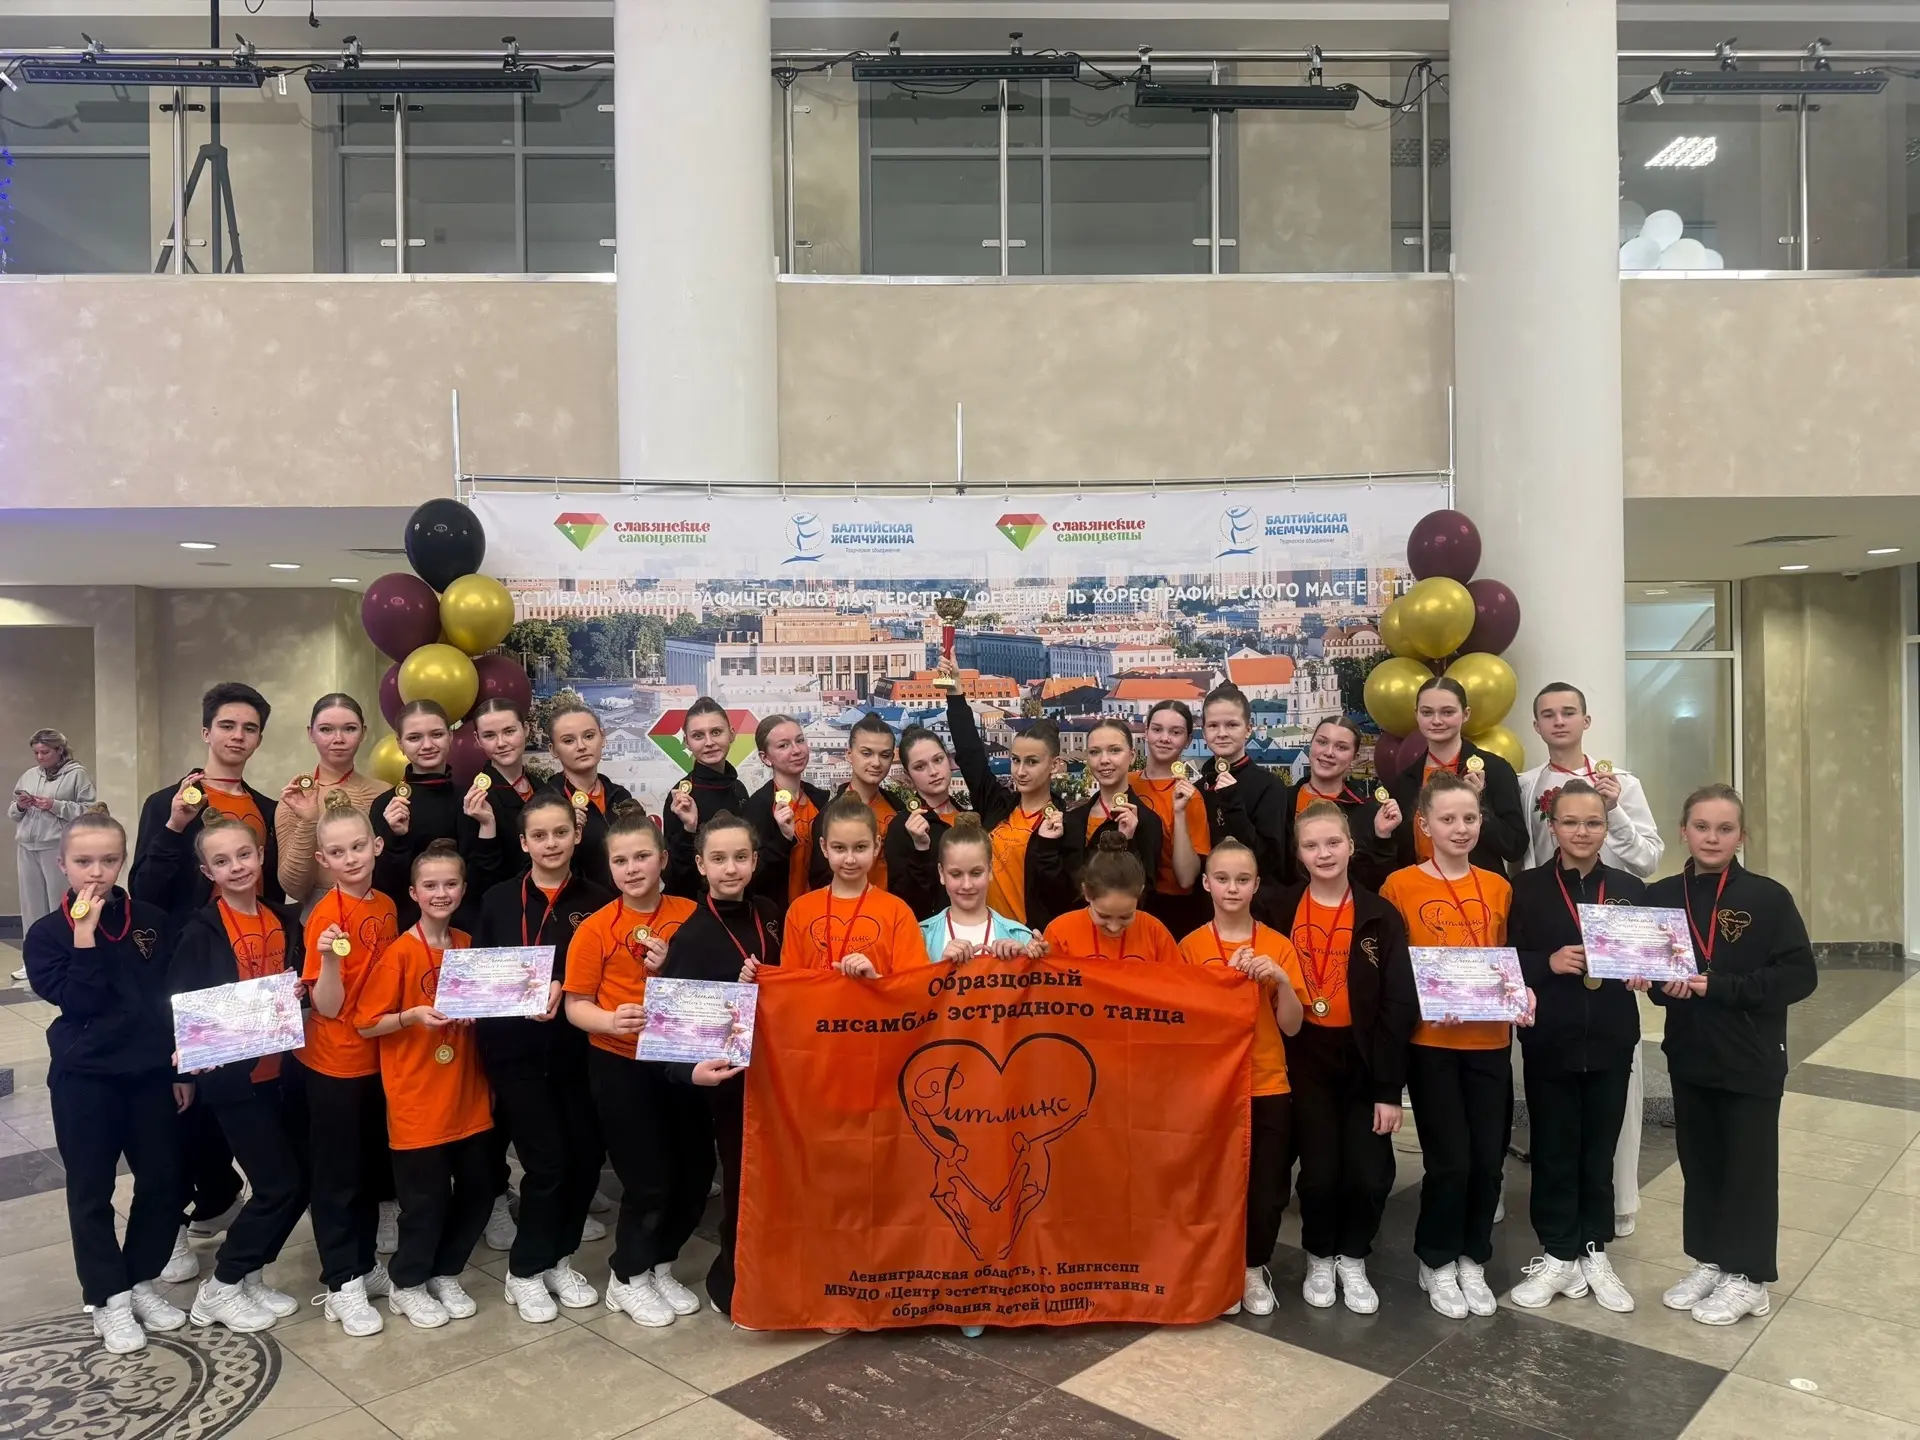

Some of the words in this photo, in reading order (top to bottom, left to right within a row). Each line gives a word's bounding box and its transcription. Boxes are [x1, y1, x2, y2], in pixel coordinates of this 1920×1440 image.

[613, 520, 711, 532] славянские
[1052, 517, 1146, 532] славянские
[1265, 512, 1347, 525] БАЛТИЙСКАЯ
[832, 521, 913, 533] БАЛТИЙСКАЯ
[1264, 524, 1349, 536] ЖЕМЧУЖИНА
[618, 533, 706, 545] самоцветы
[830, 534, 915, 544] ЖЕМЧУЖИНА
[1057, 531, 1141, 544] самоцветы
[512, 590, 612, 607] ЕСТИВАЛЬ
[616, 590, 829, 607] ХОРЕОГРАФИЧЕСКОГО
[975, 589, 1087, 605] ФЕСТИВАЛЬ
[1092, 582, 1300, 604] ХОРЕОГРАФИЧЕСКОГО
[1305, 580, 1413, 598] МАСТЕРСТВ
[928, 968, 1083, 997] Образцовый
[815, 1009, 938, 1034] ансамбль
[947, 1000, 1095, 1024] эстрадного
[1104, 1003, 1185, 1025] танца
[911, 1061, 1071, 1124] Ритмикс
[849, 1269, 969, 1283] Ленинградская
[974, 1264, 1036, 1279] область,
[1040, 1266, 1052, 1276] г.
[1056, 1262, 1139, 1275] Кингисепп
[824, 1283, 880, 1301] МБУДО
[884, 1286, 940, 1300] «Центр
[945, 1281, 1055, 1297] эстетического
[1060, 1279, 1150, 1293] воспитания
[1154, 1284, 1166, 1295] и
[892, 1302, 991, 1319] образования
[996, 1298, 1040, 1315] детей
[1044, 1297, 1096, 1314] (ДШИ)»
